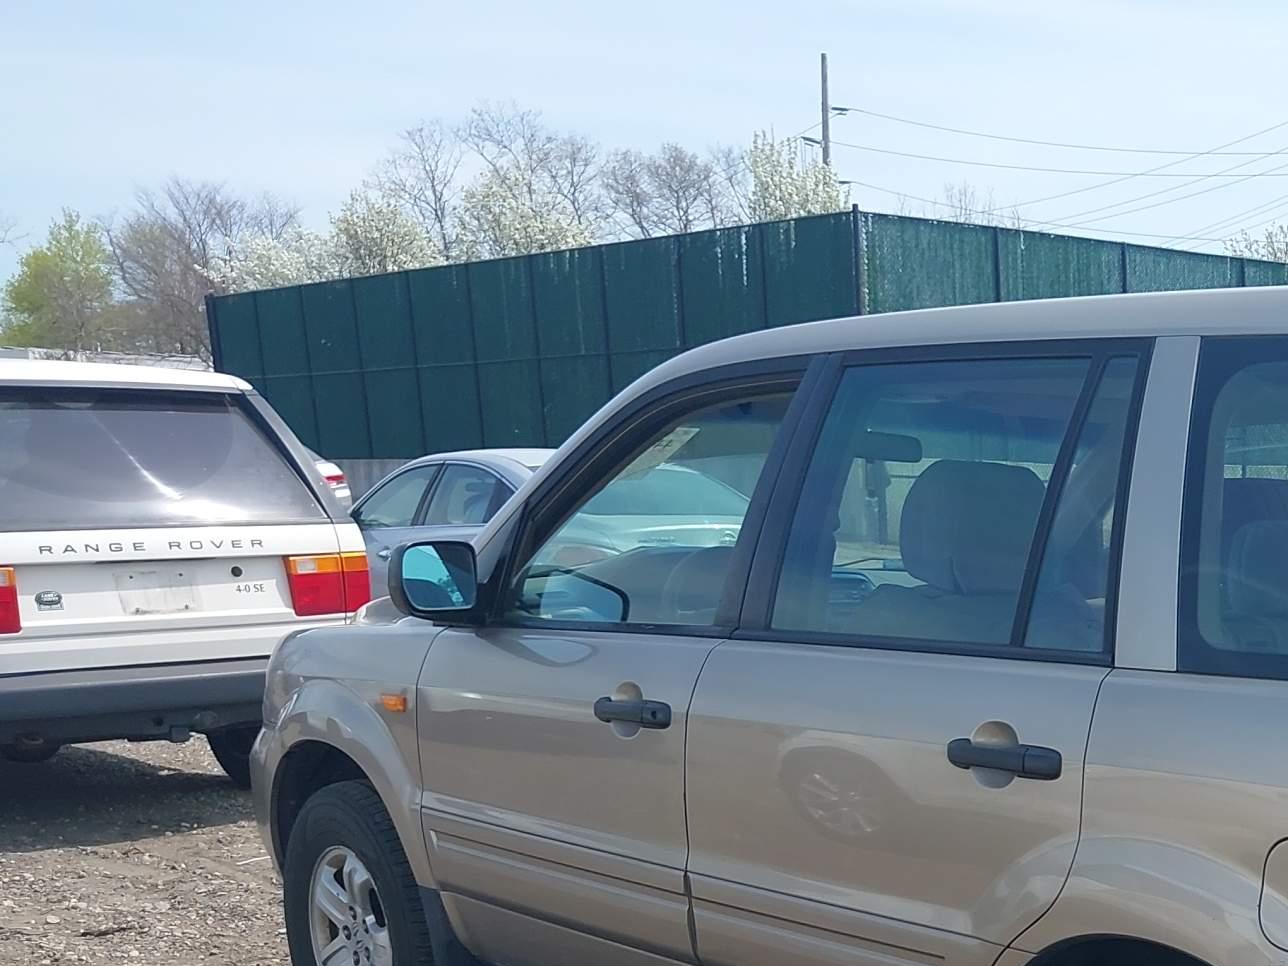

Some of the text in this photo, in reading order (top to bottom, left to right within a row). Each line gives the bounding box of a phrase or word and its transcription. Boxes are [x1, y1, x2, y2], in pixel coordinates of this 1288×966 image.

[38, 538, 264, 555] RANGE ROVER
[253, 583, 266, 593] SE
